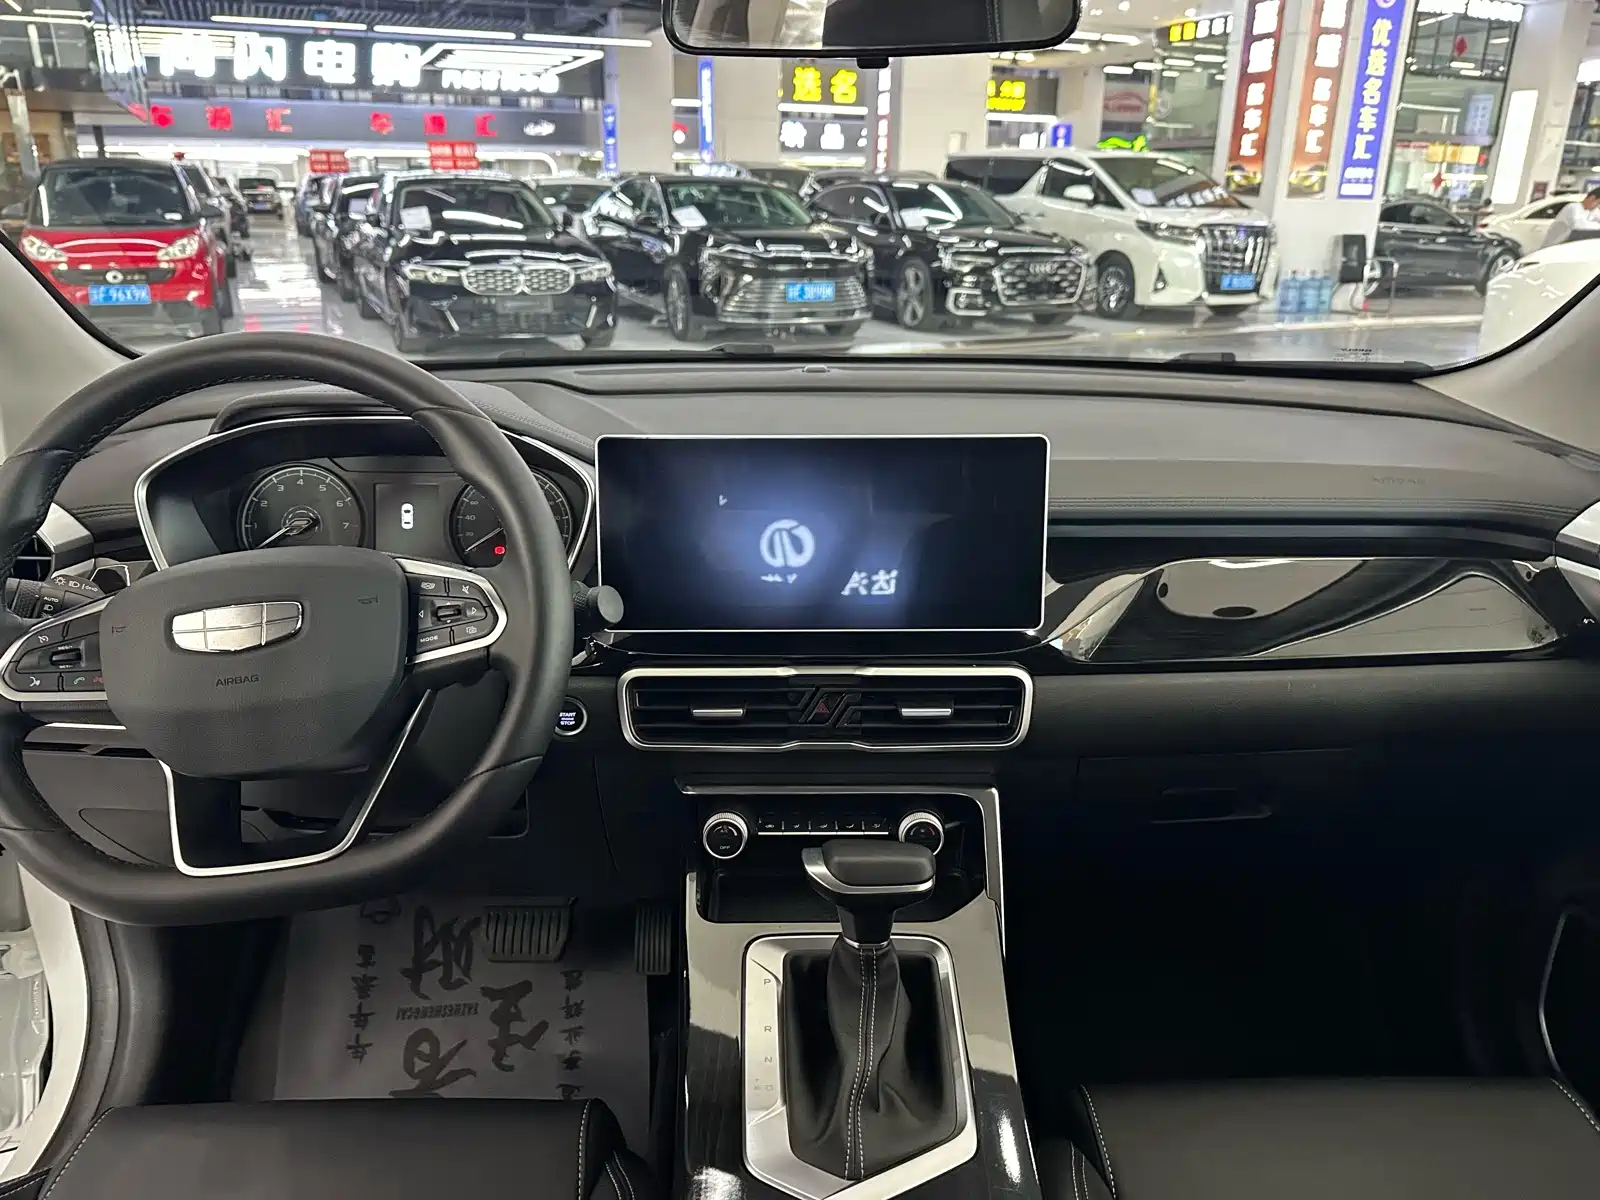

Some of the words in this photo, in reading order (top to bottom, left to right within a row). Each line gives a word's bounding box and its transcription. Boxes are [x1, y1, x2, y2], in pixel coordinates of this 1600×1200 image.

[1352, 18, 1392, 160] 优选名车汇
[216, 674, 260, 688] AIRBAG
